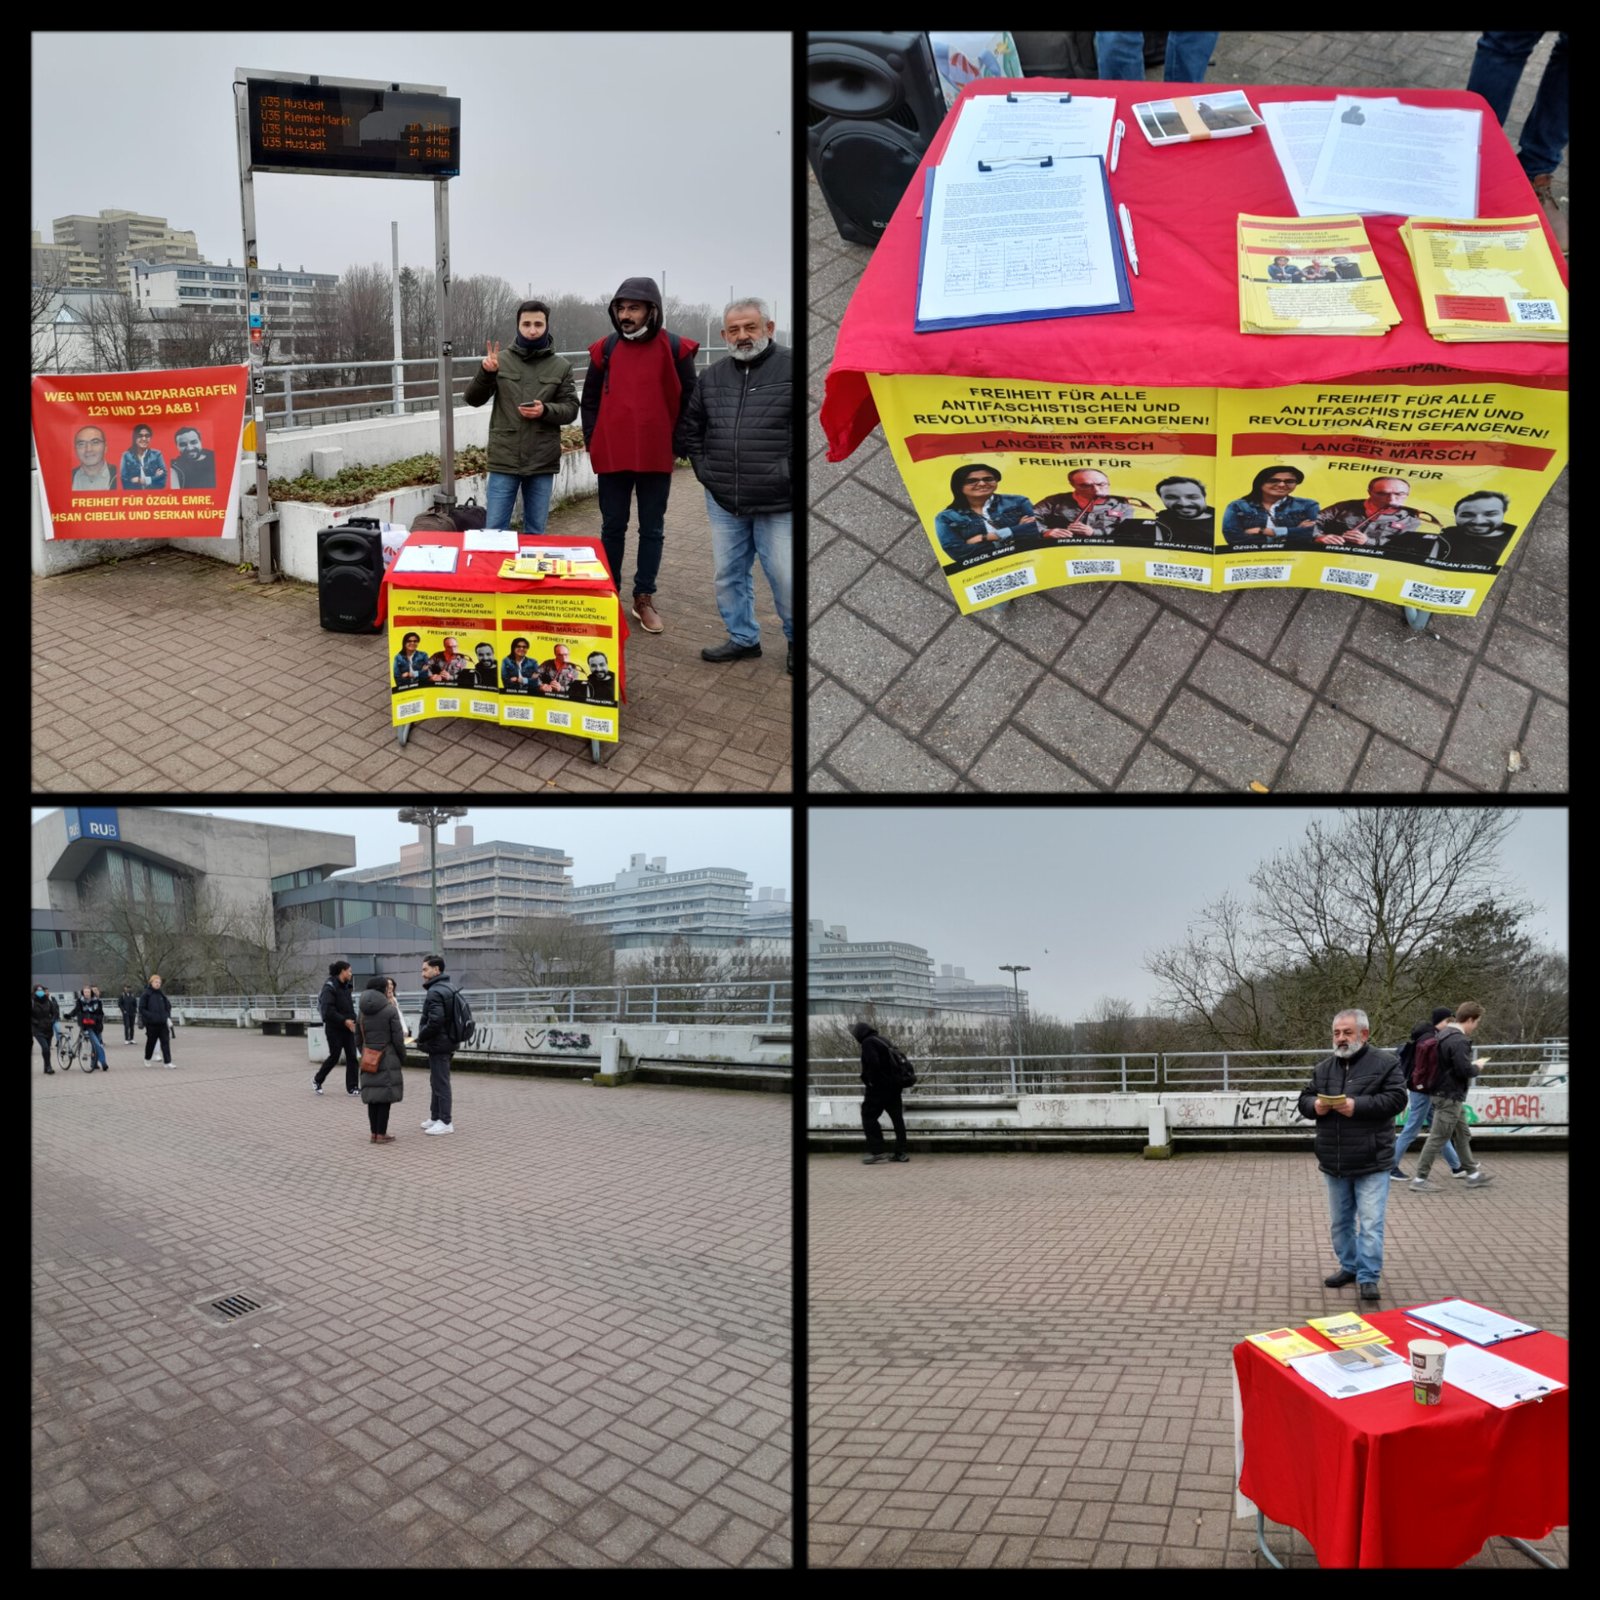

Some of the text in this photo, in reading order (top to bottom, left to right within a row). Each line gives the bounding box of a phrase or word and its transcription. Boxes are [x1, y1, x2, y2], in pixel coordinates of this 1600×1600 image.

[260, 96, 326, 111] U35 Hustadt
[261, 109, 280, 121] U35
[284, 112, 321, 124] Riemke
[262, 123, 281, 135] U35
[284, 124, 326, 138] Hustadt
[262, 136, 281, 148] U35
[285, 138, 327, 151] Hustadt
[44, 384, 236, 402] WEG MIT DEM NAZIPARAGRAFEN
[970, 387, 1147, 401] FREIHEIT FÜR ALLE
[1317, 393, 1496, 406] FREIHEIT FÜR ALLE
[88, 406, 109, 416] 129
[112, 406, 135, 416] UND
[140, 404, 162, 415] 129
[165, 402, 192, 414] A&B
[941, 400, 1180, 413] ANTIFASCHISTISCHEN UND
[1280, 405, 1524, 421] ANTIFASCHISTISCHEN UND
[914, 414, 1210, 426] REVOLUTIONÄREN GEFANGENEN!
[1249, 416, 1550, 439] REVOLUTIONÄREN GEFANGENEN!
[982, 439, 1154, 451] LANGER MARSCH
[1302, 442, 1476, 461] LANGER MARSCH
[1019, 457, 1132, 469] FREIHEIT FÜR
[1328, 462, 1443, 480] FREIHEIT FÜR
[72, 494, 214, 507] FREIHEIT FÜR ÖZGÜL EMRE,
[84, 511, 126, 521] CIBELIK
[128, 510, 150, 520] UND
[153, 509, 194, 520] SERKAN
[90, 822, 116, 836] RUB
